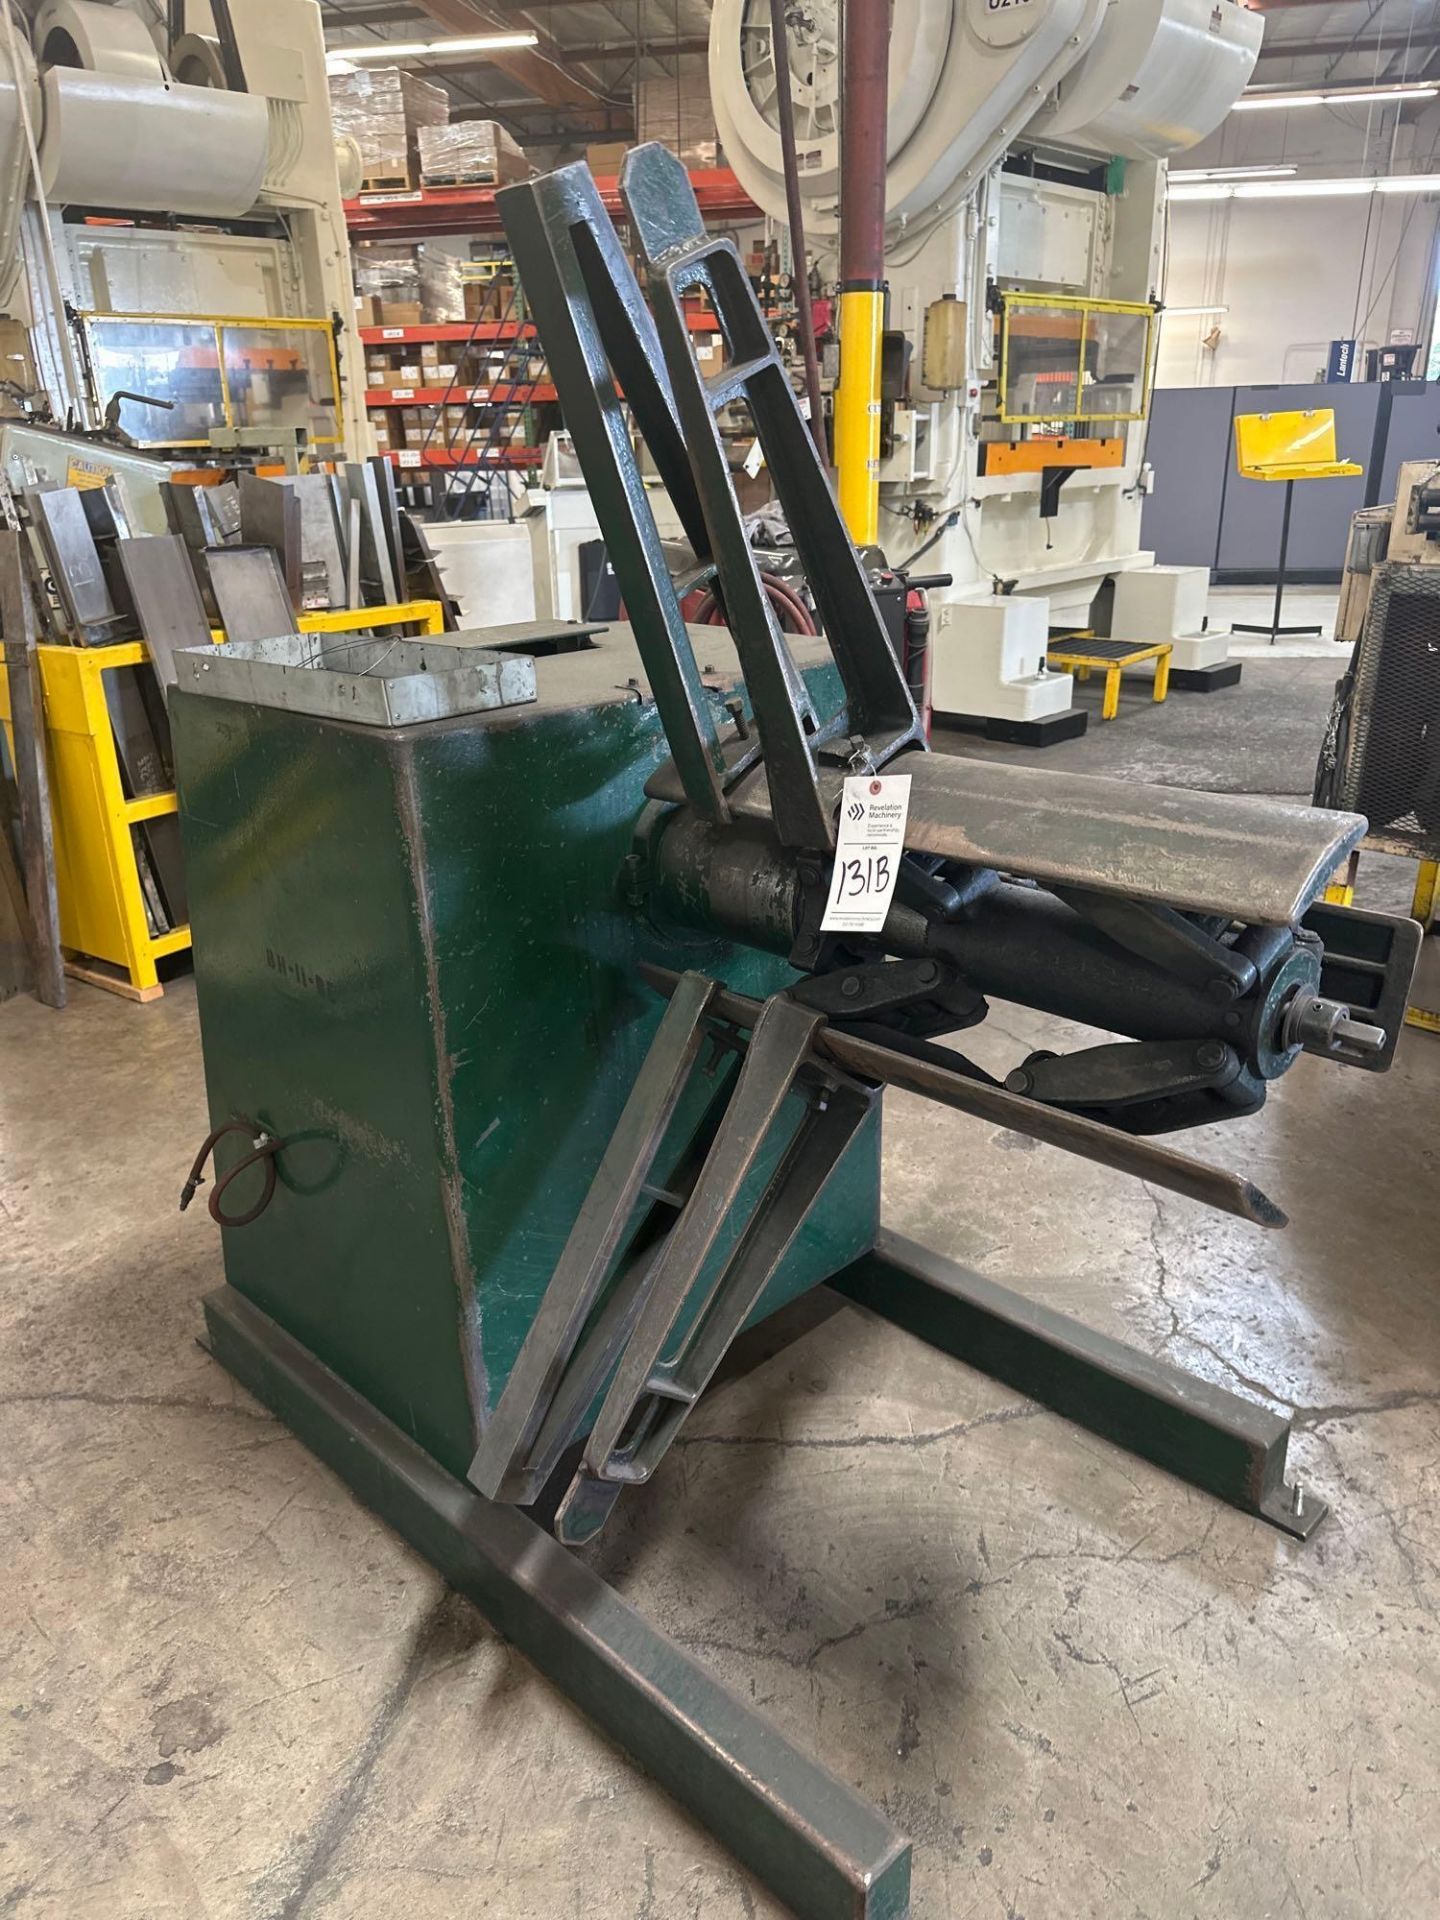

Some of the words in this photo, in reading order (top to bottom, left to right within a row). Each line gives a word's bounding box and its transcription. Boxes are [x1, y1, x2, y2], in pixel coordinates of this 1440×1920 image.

[1336, 343, 1349, 377] Lantech
[868, 811, 902, 820] Machinery
[869, 803, 902, 811] Revelation
[836, 856, 889, 904] 131B
